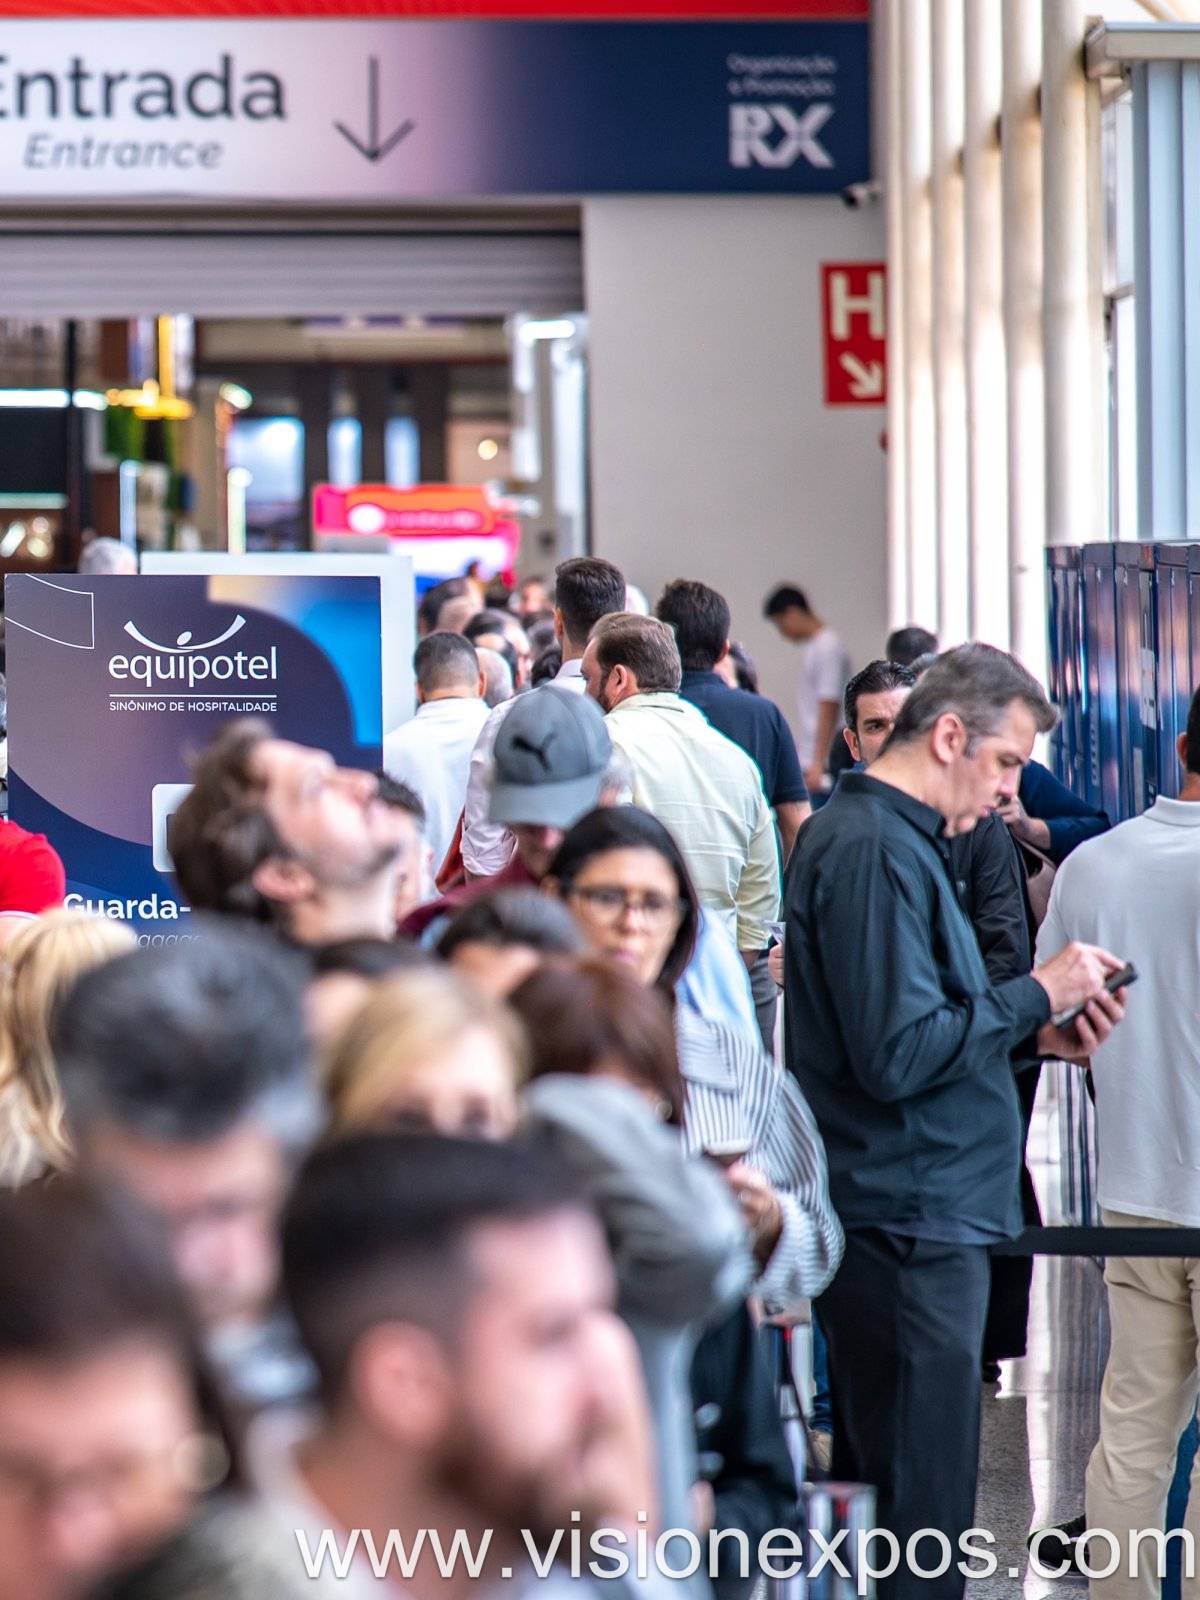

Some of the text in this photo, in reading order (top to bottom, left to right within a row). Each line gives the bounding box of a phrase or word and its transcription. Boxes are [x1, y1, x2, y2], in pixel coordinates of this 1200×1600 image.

[23, 132, 225, 170] Entrance
[729, 104, 835, 168] RX
[830, 271, 885, 341] H
[108, 646, 277, 687] equipotel
[109, 700, 277, 712] SINÔNIMO DE HOSPITALIDADE
